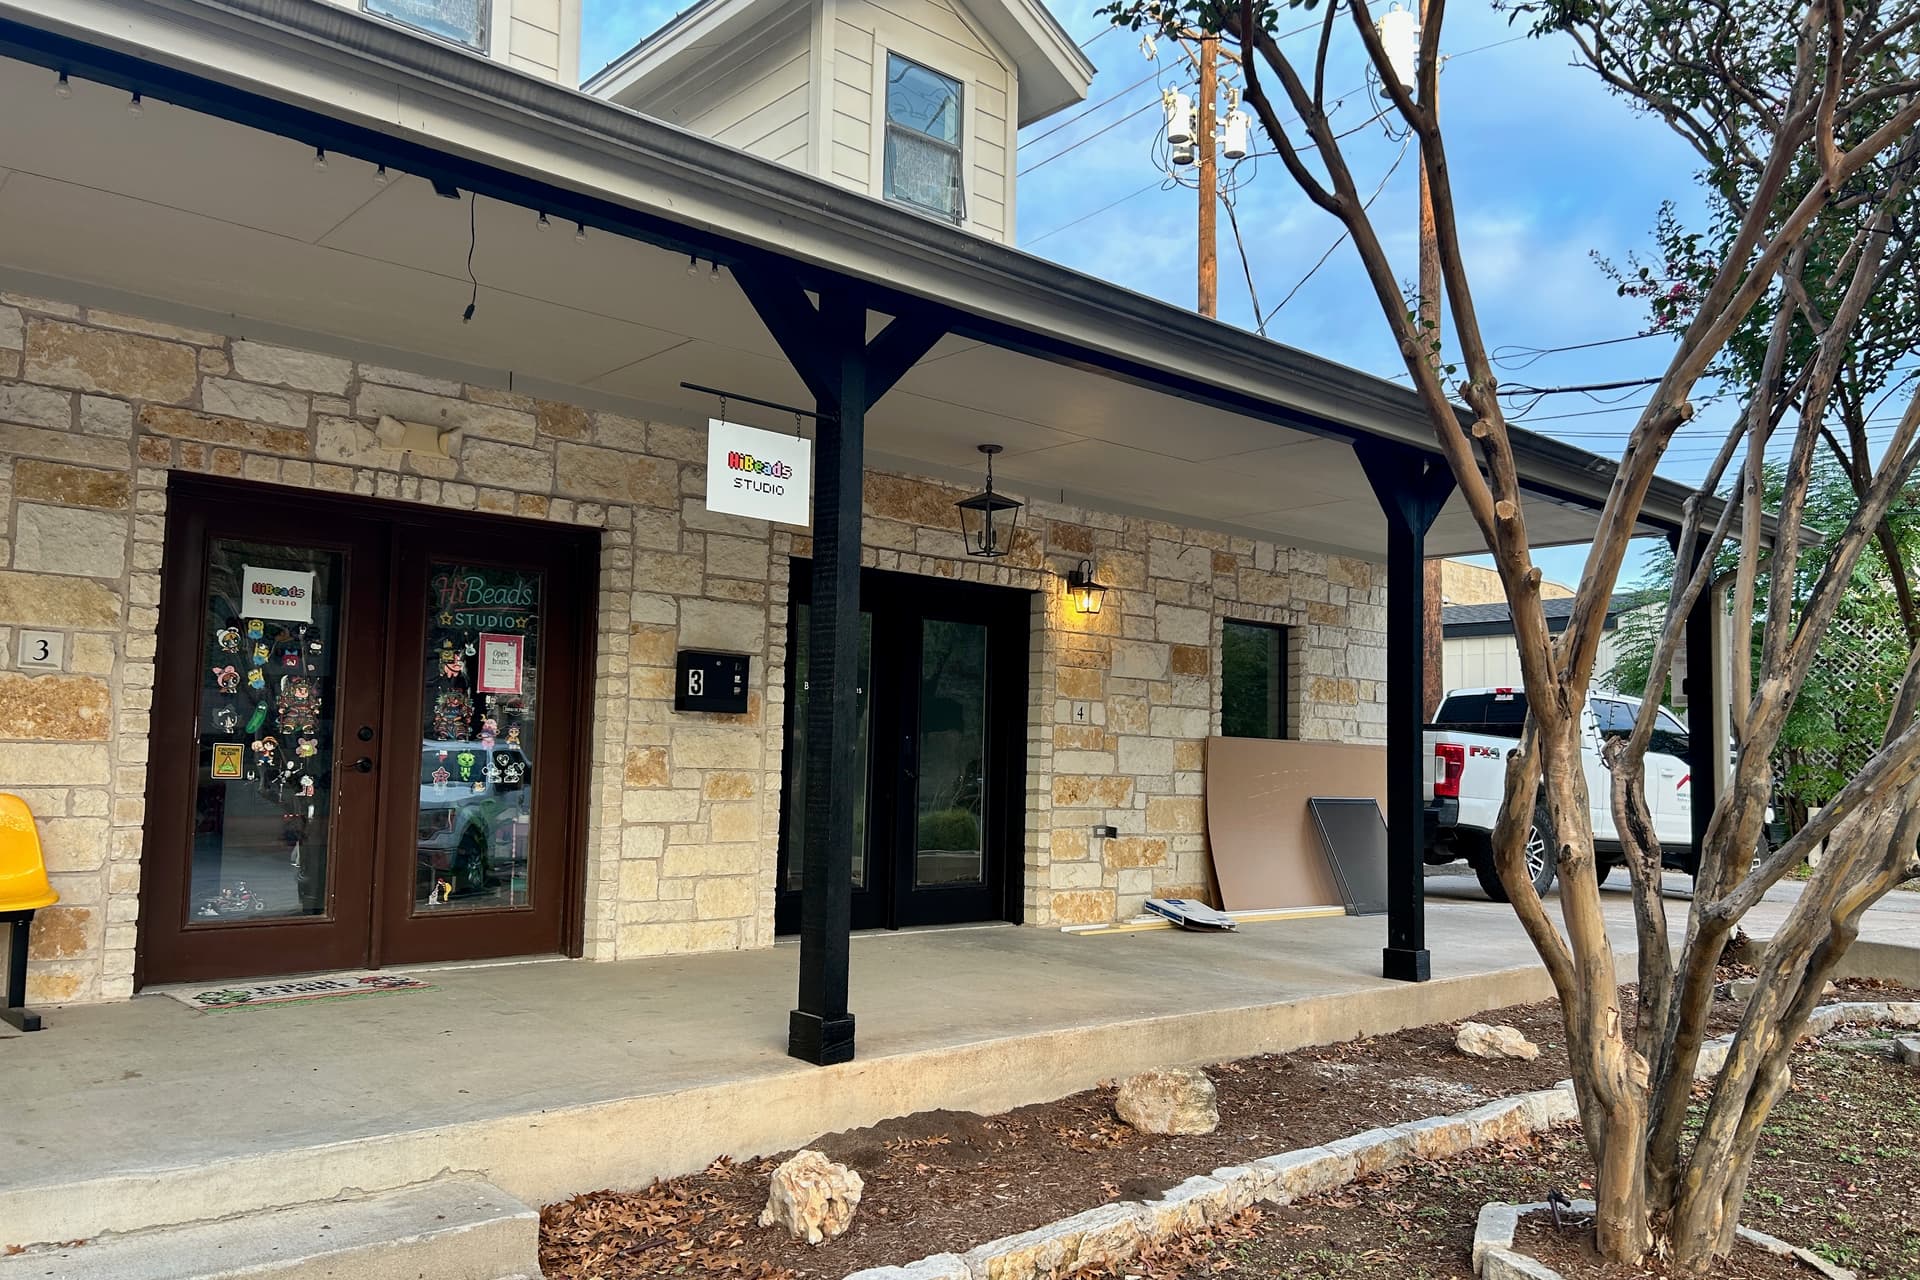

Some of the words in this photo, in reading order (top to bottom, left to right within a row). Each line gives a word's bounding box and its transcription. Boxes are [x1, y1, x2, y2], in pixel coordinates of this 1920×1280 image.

[728, 451, 792, 480] HiBeads
[734, 477, 785, 496] STUDIO
[252, 582, 305, 598] HiBeads
[435, 576, 532, 606] HiBeads
[260, 598, 297, 607] STUDIO
[455, 613, 515, 628] STUDIO
[32, 639, 49, 661] 3
[492, 650, 510, 659] Open
[690, 670, 702, 695] 3
[1077, 706, 1085, 720] 4
[1469, 745, 1500, 758] FX4
